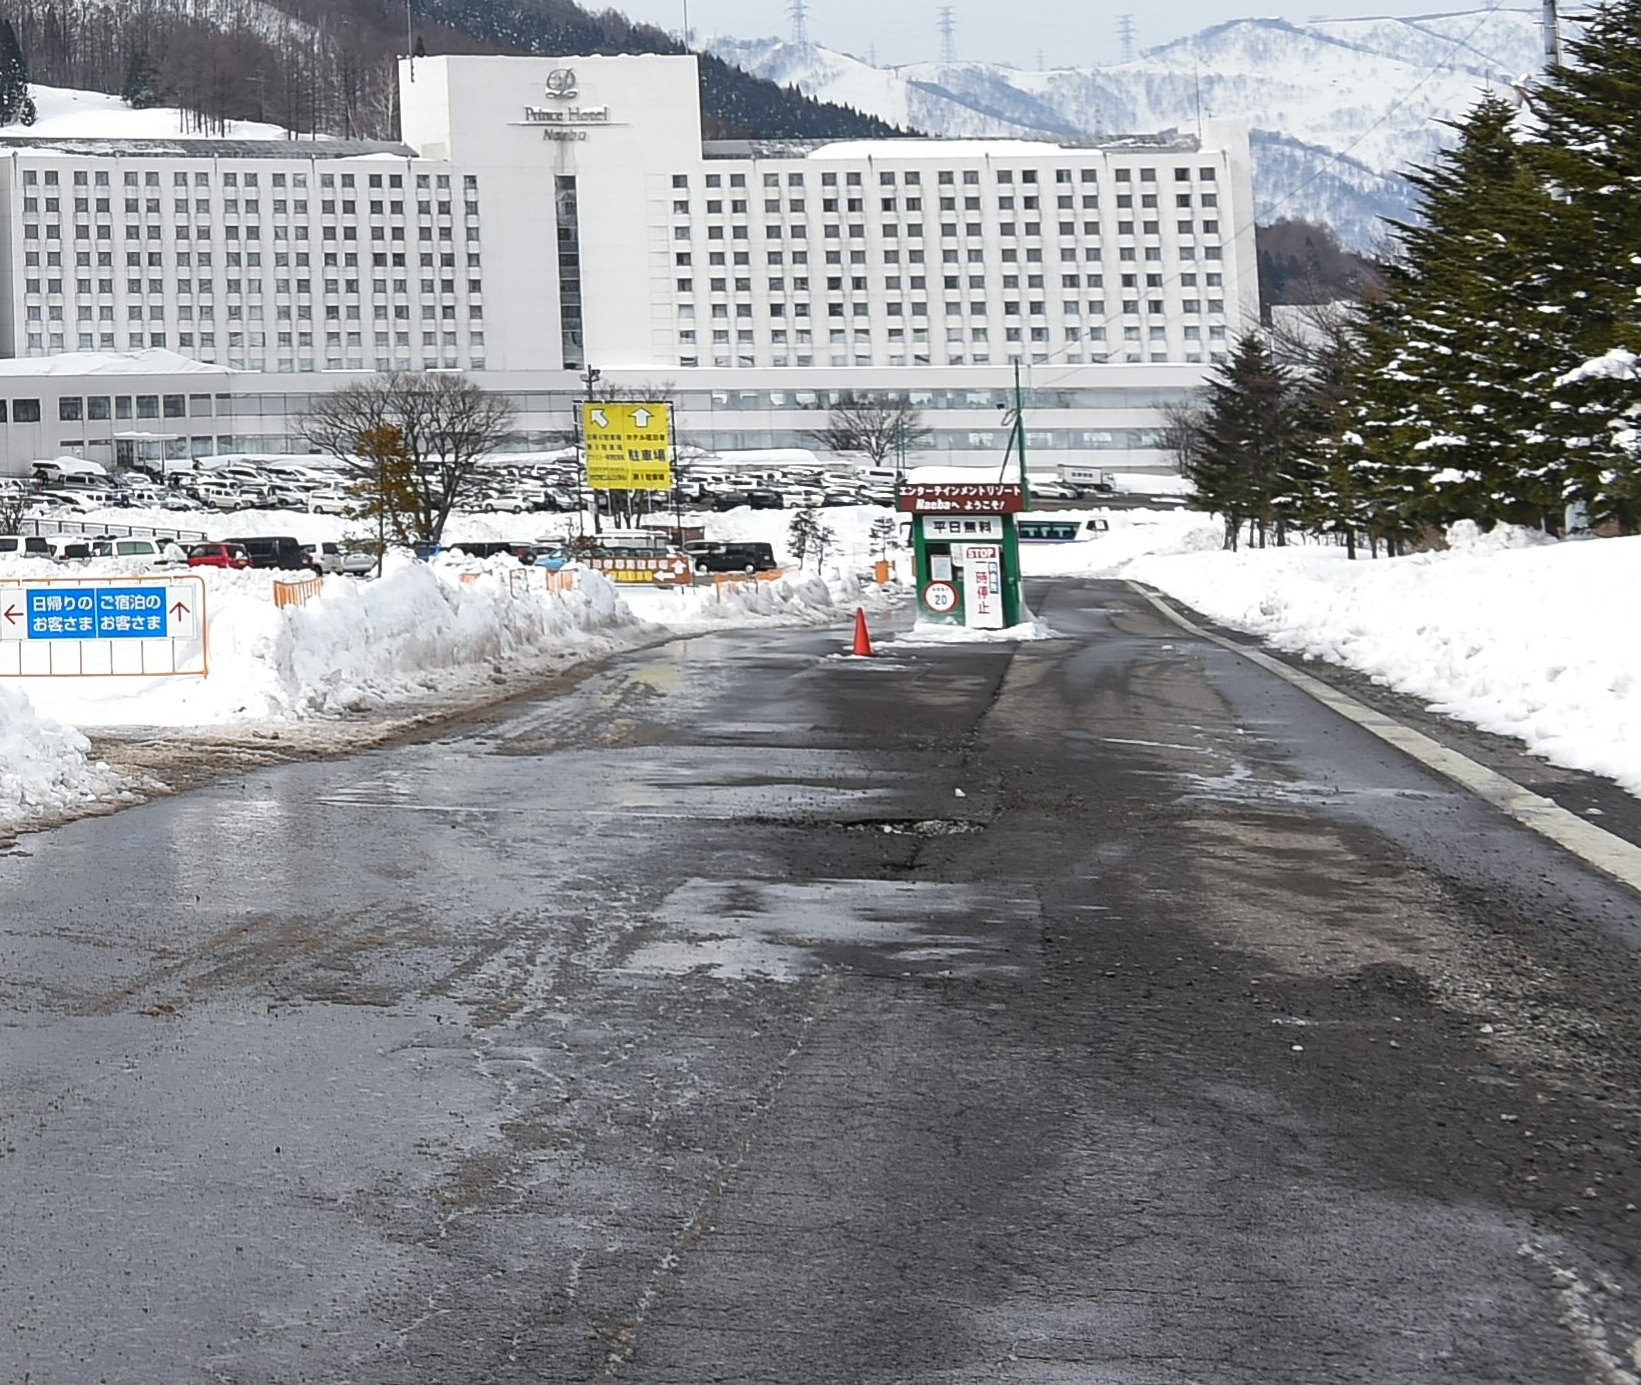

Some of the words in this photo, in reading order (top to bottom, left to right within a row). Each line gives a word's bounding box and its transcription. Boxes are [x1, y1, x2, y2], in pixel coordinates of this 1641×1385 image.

[524, 106, 564, 121] Prince
[543, 129, 587, 141] Naeba
[899, 485, 1021, 496] エンターテインメントリゾート
[933, 520, 992, 533] 平日無料
[967, 548, 994, 559] STOP
[33, 596, 93, 611] 日帰りの
[100, 594, 161, 610] ご宿泊の
[935, 594, 948, 605] 20
[33, 616, 93, 632] お客さま
[100, 615, 161, 631] お客さま
